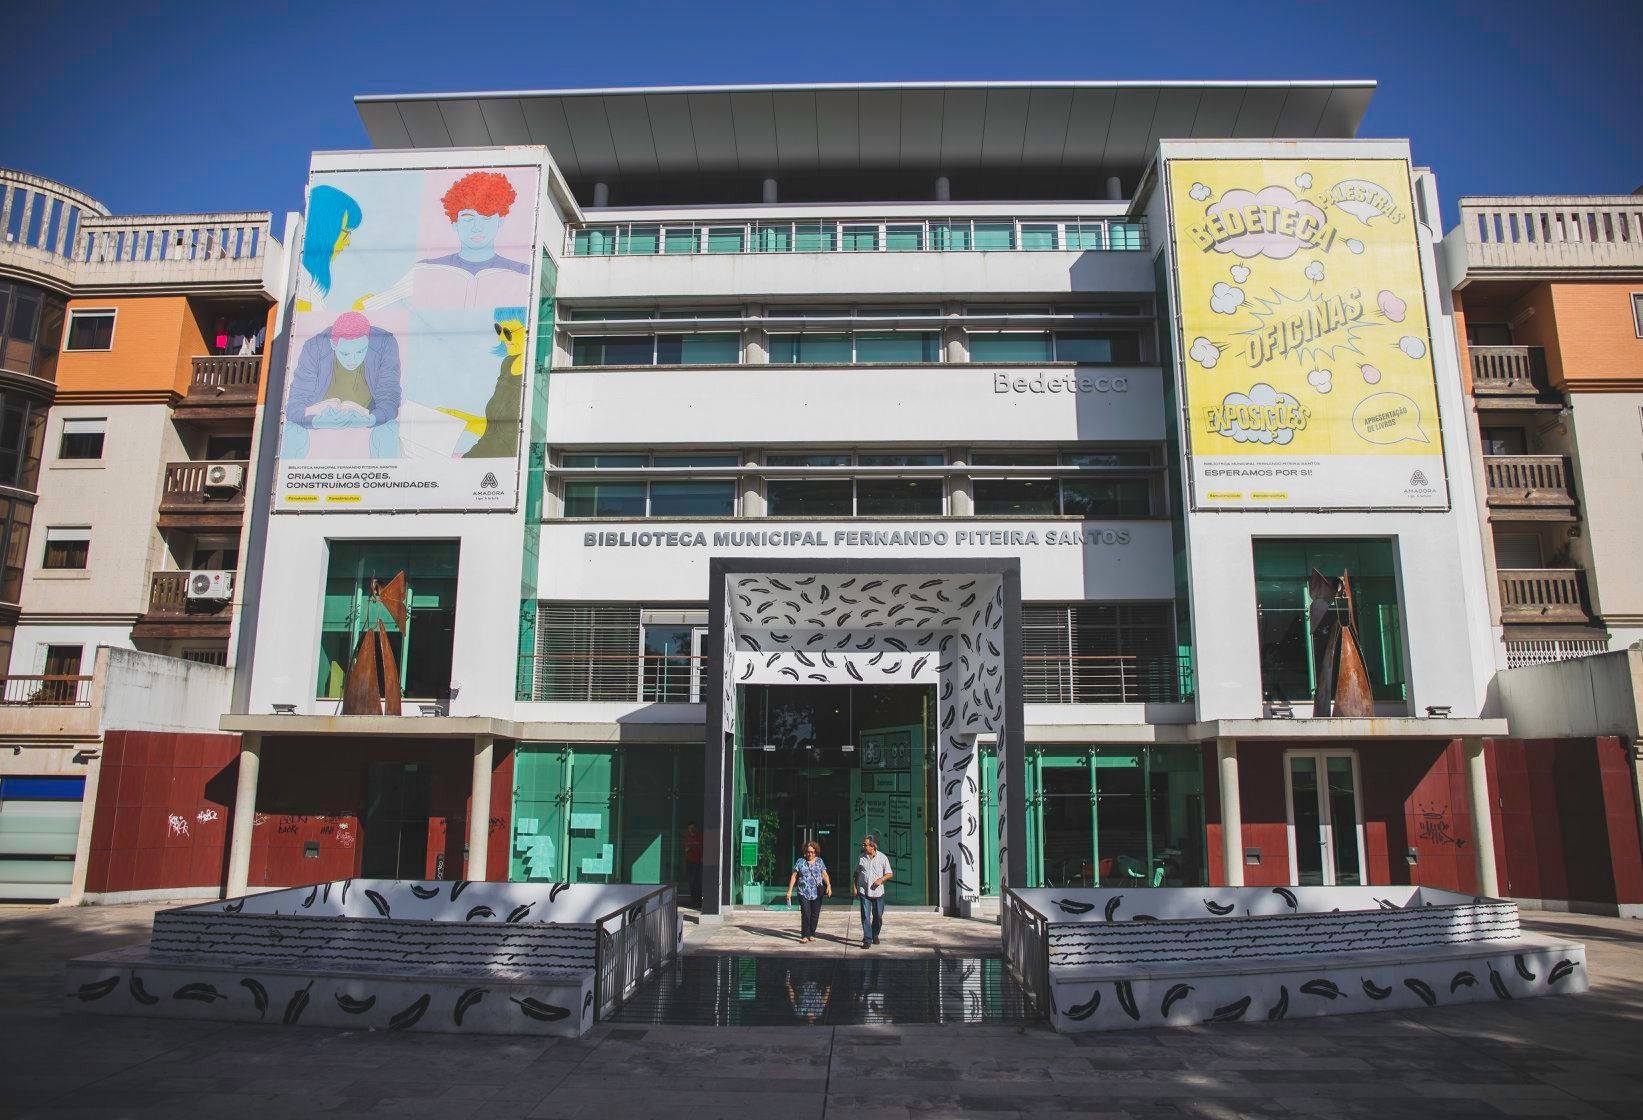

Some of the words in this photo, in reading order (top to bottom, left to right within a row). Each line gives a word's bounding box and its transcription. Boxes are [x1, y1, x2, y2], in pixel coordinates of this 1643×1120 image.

[1314, 183, 1406, 225] PALESTRAS
[1184, 204, 1337, 254] BEDETECA
[1245, 287, 1364, 368] OFICINAS
[993, 371, 1129, 394] Bedeteca
[1201, 397, 1311, 439] EXPOSIÇÕES
[1364, 406, 1408, 426] APRESENTAÇÃO
[1367, 424, 1375, 433] DE
[1376, 418, 1397, 431] LIVROS
[287, 472, 334, 480] CRIAMOS
[336, 472, 391, 481] LIGAÇÕES.
[1204, 469, 1273, 477] ESPERAMOS
[1275, 469, 1298, 477] POR
[286, 481, 361, 489] CONSTRUÍMOS
[362, 481, 440, 489] COMUNIDADES.
[583, 531, 707, 547] BIBLIOTECA
[713, 531, 828, 547] MUNICIPAL
[834, 530, 949, 546] FERNANDO
[955, 530, 1039, 546] PITEIRA
[1045, 529, 1132, 546] SANTOS
